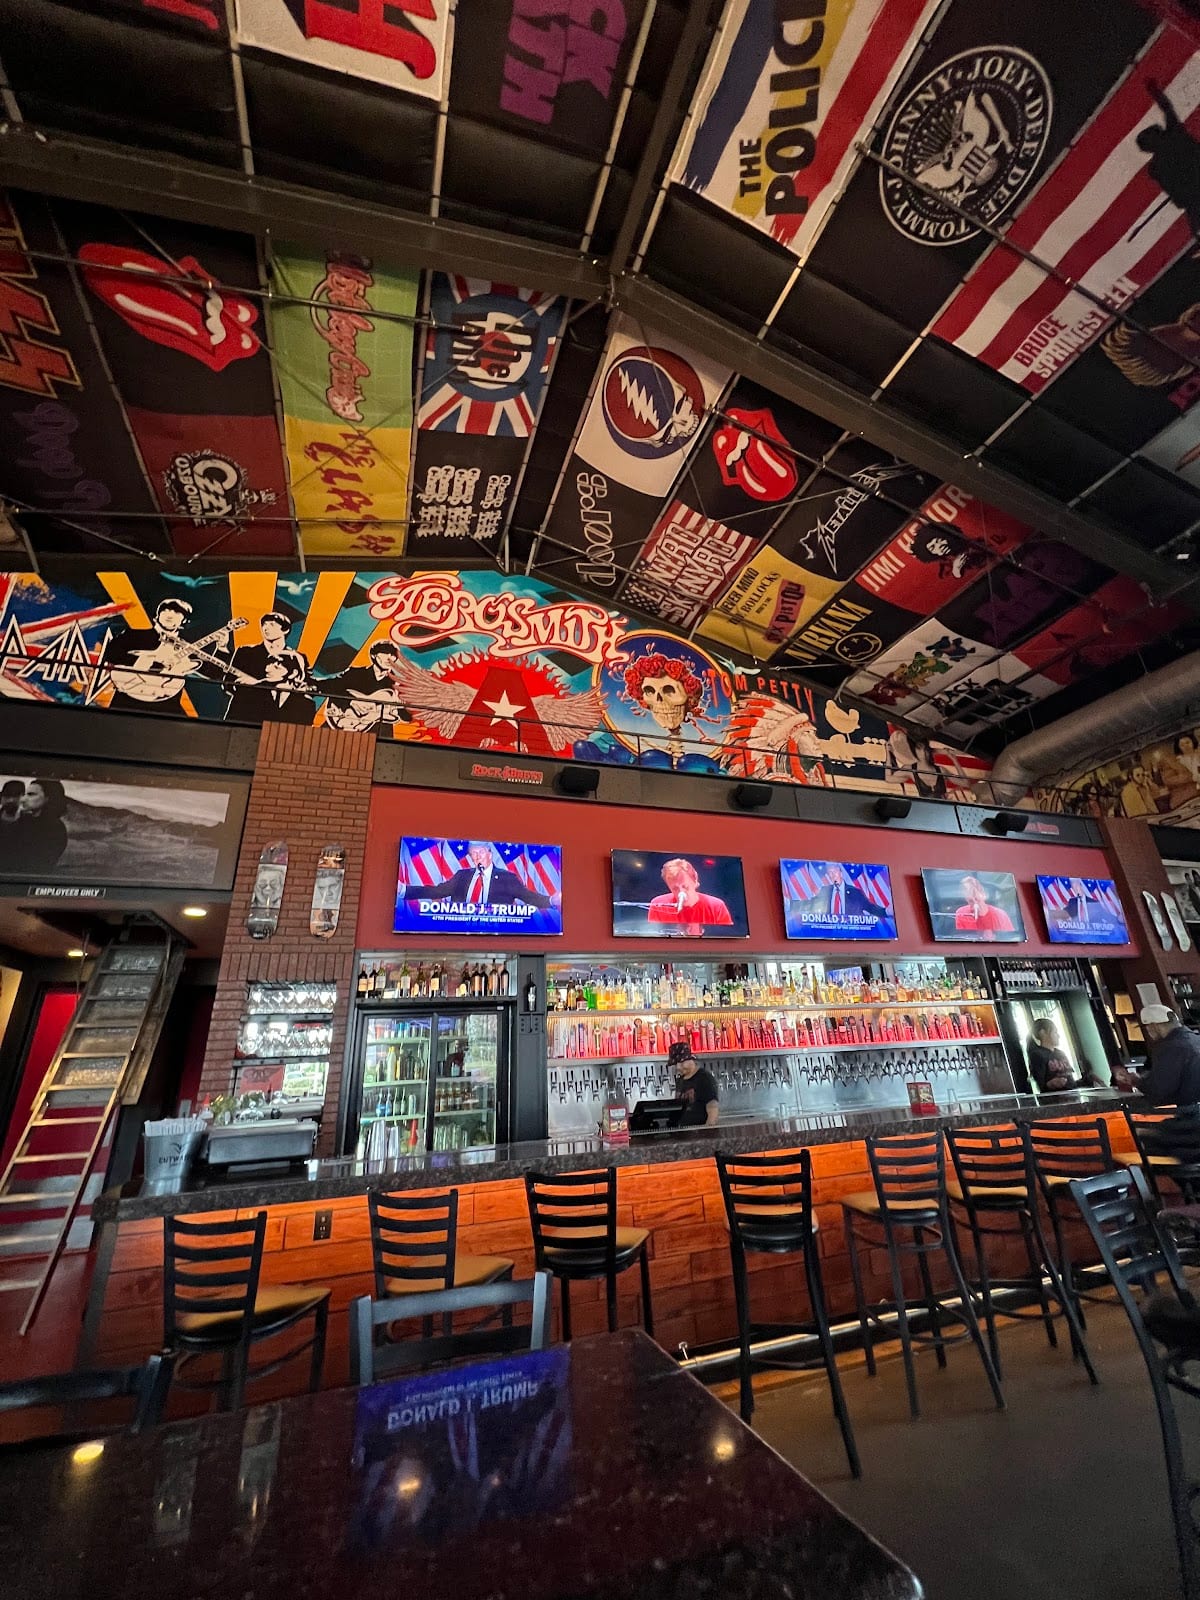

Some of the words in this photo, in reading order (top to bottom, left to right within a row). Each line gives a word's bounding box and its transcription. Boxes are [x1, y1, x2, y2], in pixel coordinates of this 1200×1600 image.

[967, 55, 1036, 92] JOEY
[887, 68, 953, 189] JOHNNY
[1018, 96, 1044, 159] DEE
[739, 137, 762, 198] THE
[980, 165, 1027, 219] DEE
[892, 201, 970, 239] TOMMY
[1013, 314, 1068, 368] BRUCE
[303, 441, 396, 556] CLASH
[861, 549, 907, 593] JIMI
[367, 573, 632, 665] AEROSMITH
[783, 597, 873, 665] NIRVANA
[707, 668, 749, 709] TOM
[757, 676, 817, 723] PETTY
[35, 887, 79, 897] EMPLOYEES
[80, 888, 100, 897] ONLY
[420, 901, 475, 914] DONALD
[478, 905, 488, 914] J.
[492, 904, 537, 916] TRUMP
[802, 913, 838, 924] DONALD
[848, 915, 879, 925] TRUMP
[1057, 920, 1085, 930] DONALD
